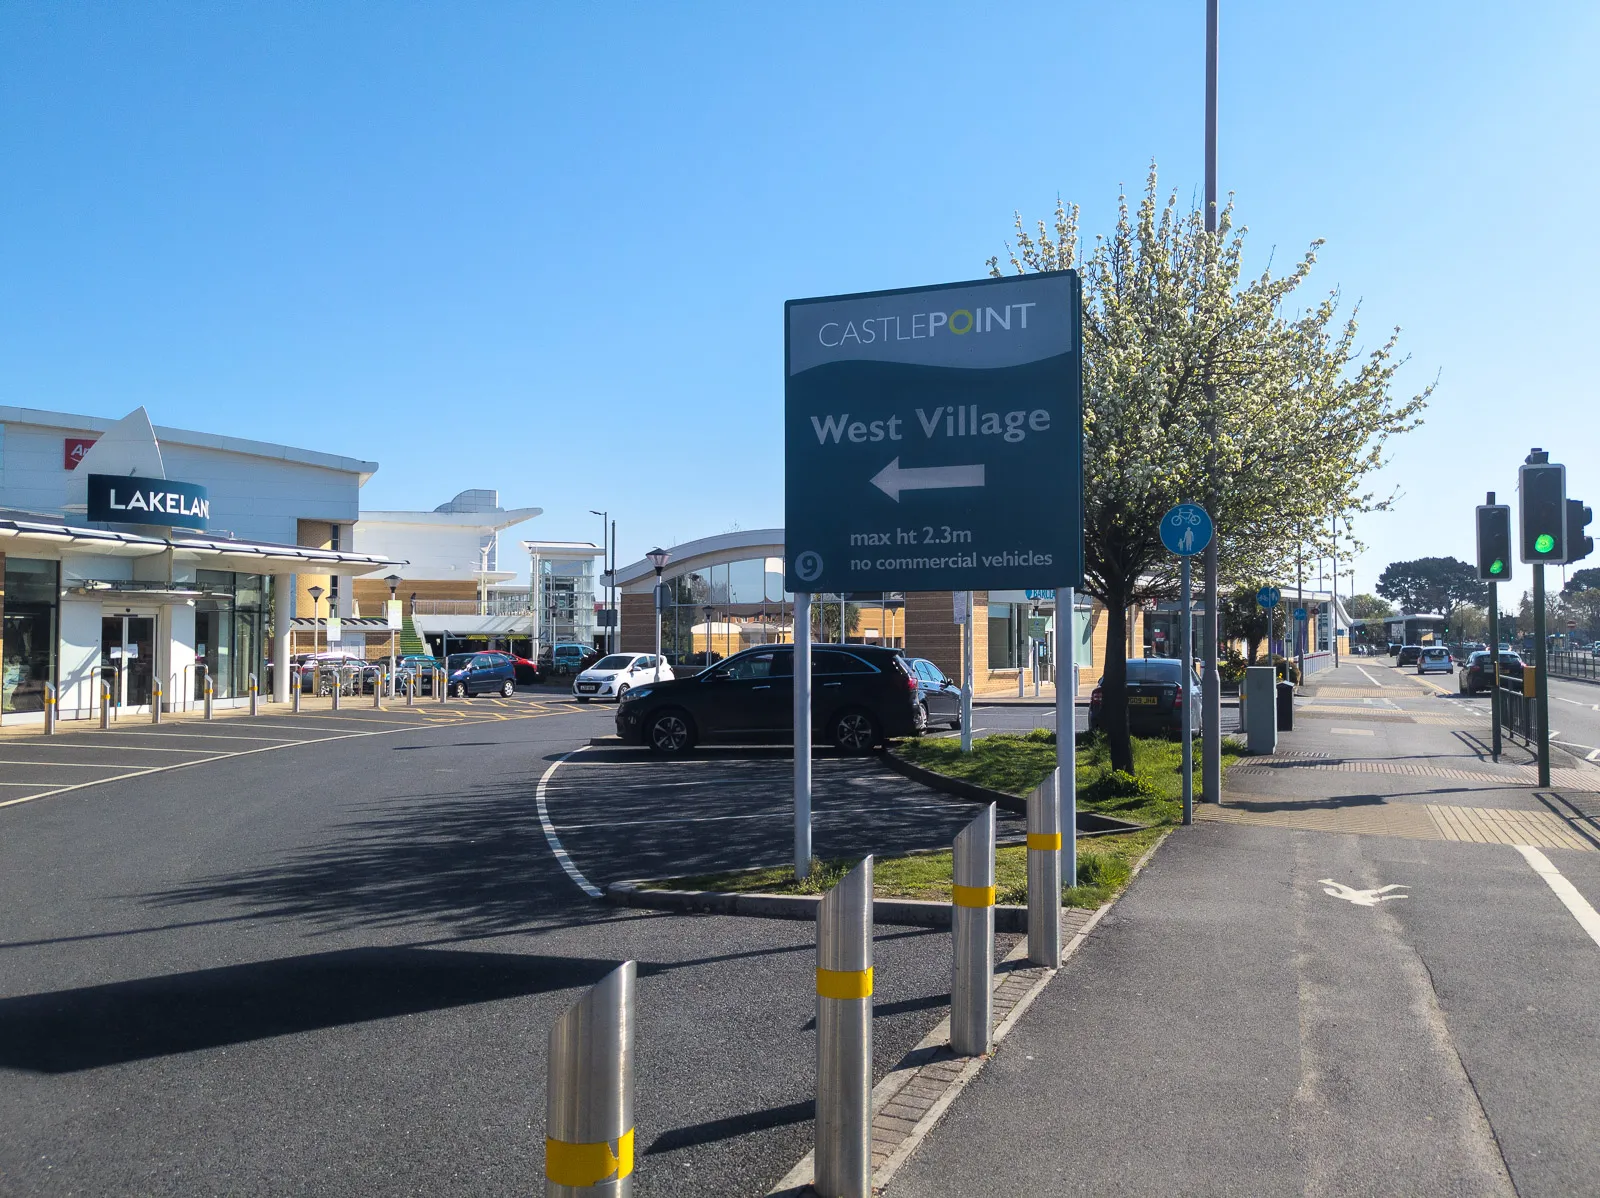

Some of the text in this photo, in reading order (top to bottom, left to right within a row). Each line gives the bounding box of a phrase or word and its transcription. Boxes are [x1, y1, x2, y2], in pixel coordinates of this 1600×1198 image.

[818, 302, 1036, 347] CASTLEPOINT
[810, 404, 1051, 445] West Village
[850, 526, 972, 546] max ht 2.3m
[851, 549, 1053, 571] no commercial vehicles
